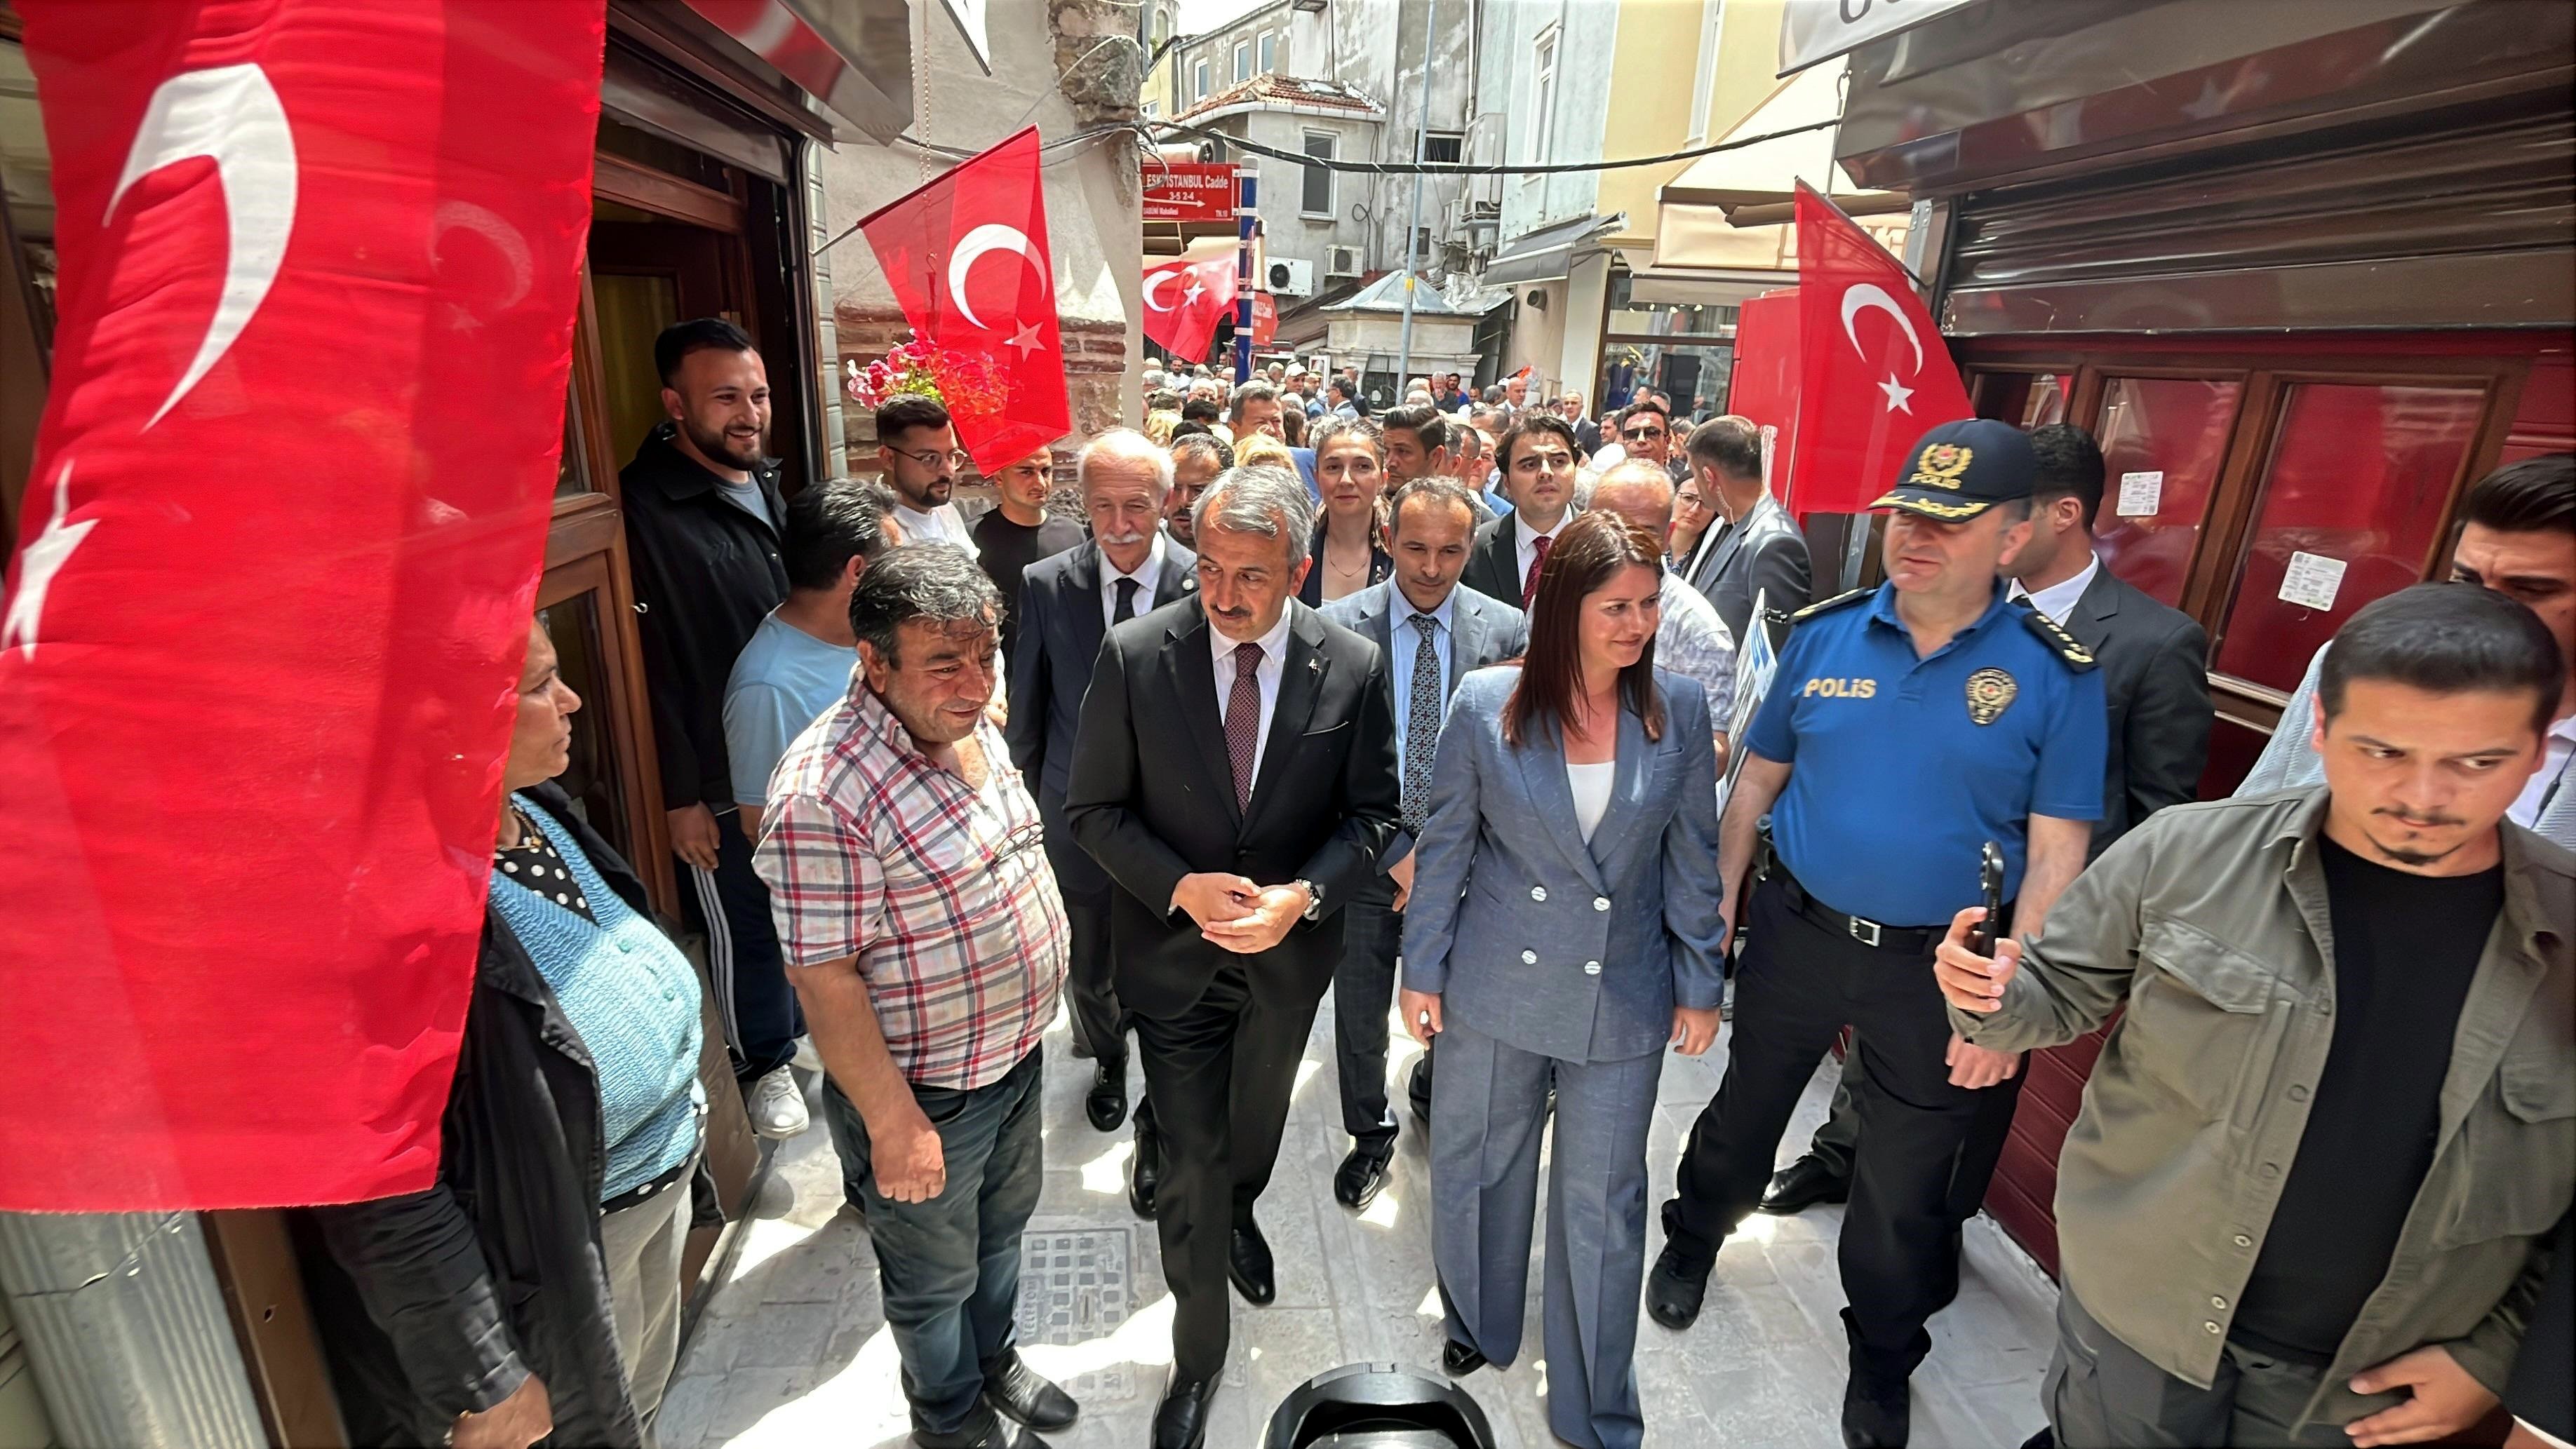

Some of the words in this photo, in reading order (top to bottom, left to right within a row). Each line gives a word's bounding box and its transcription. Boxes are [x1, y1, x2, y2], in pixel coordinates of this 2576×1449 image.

[1205, 174, 1228, 189] Cadde
[1169, 191, 1181, 201] 3-5
[1182, 191, 1195, 201] 2-4
